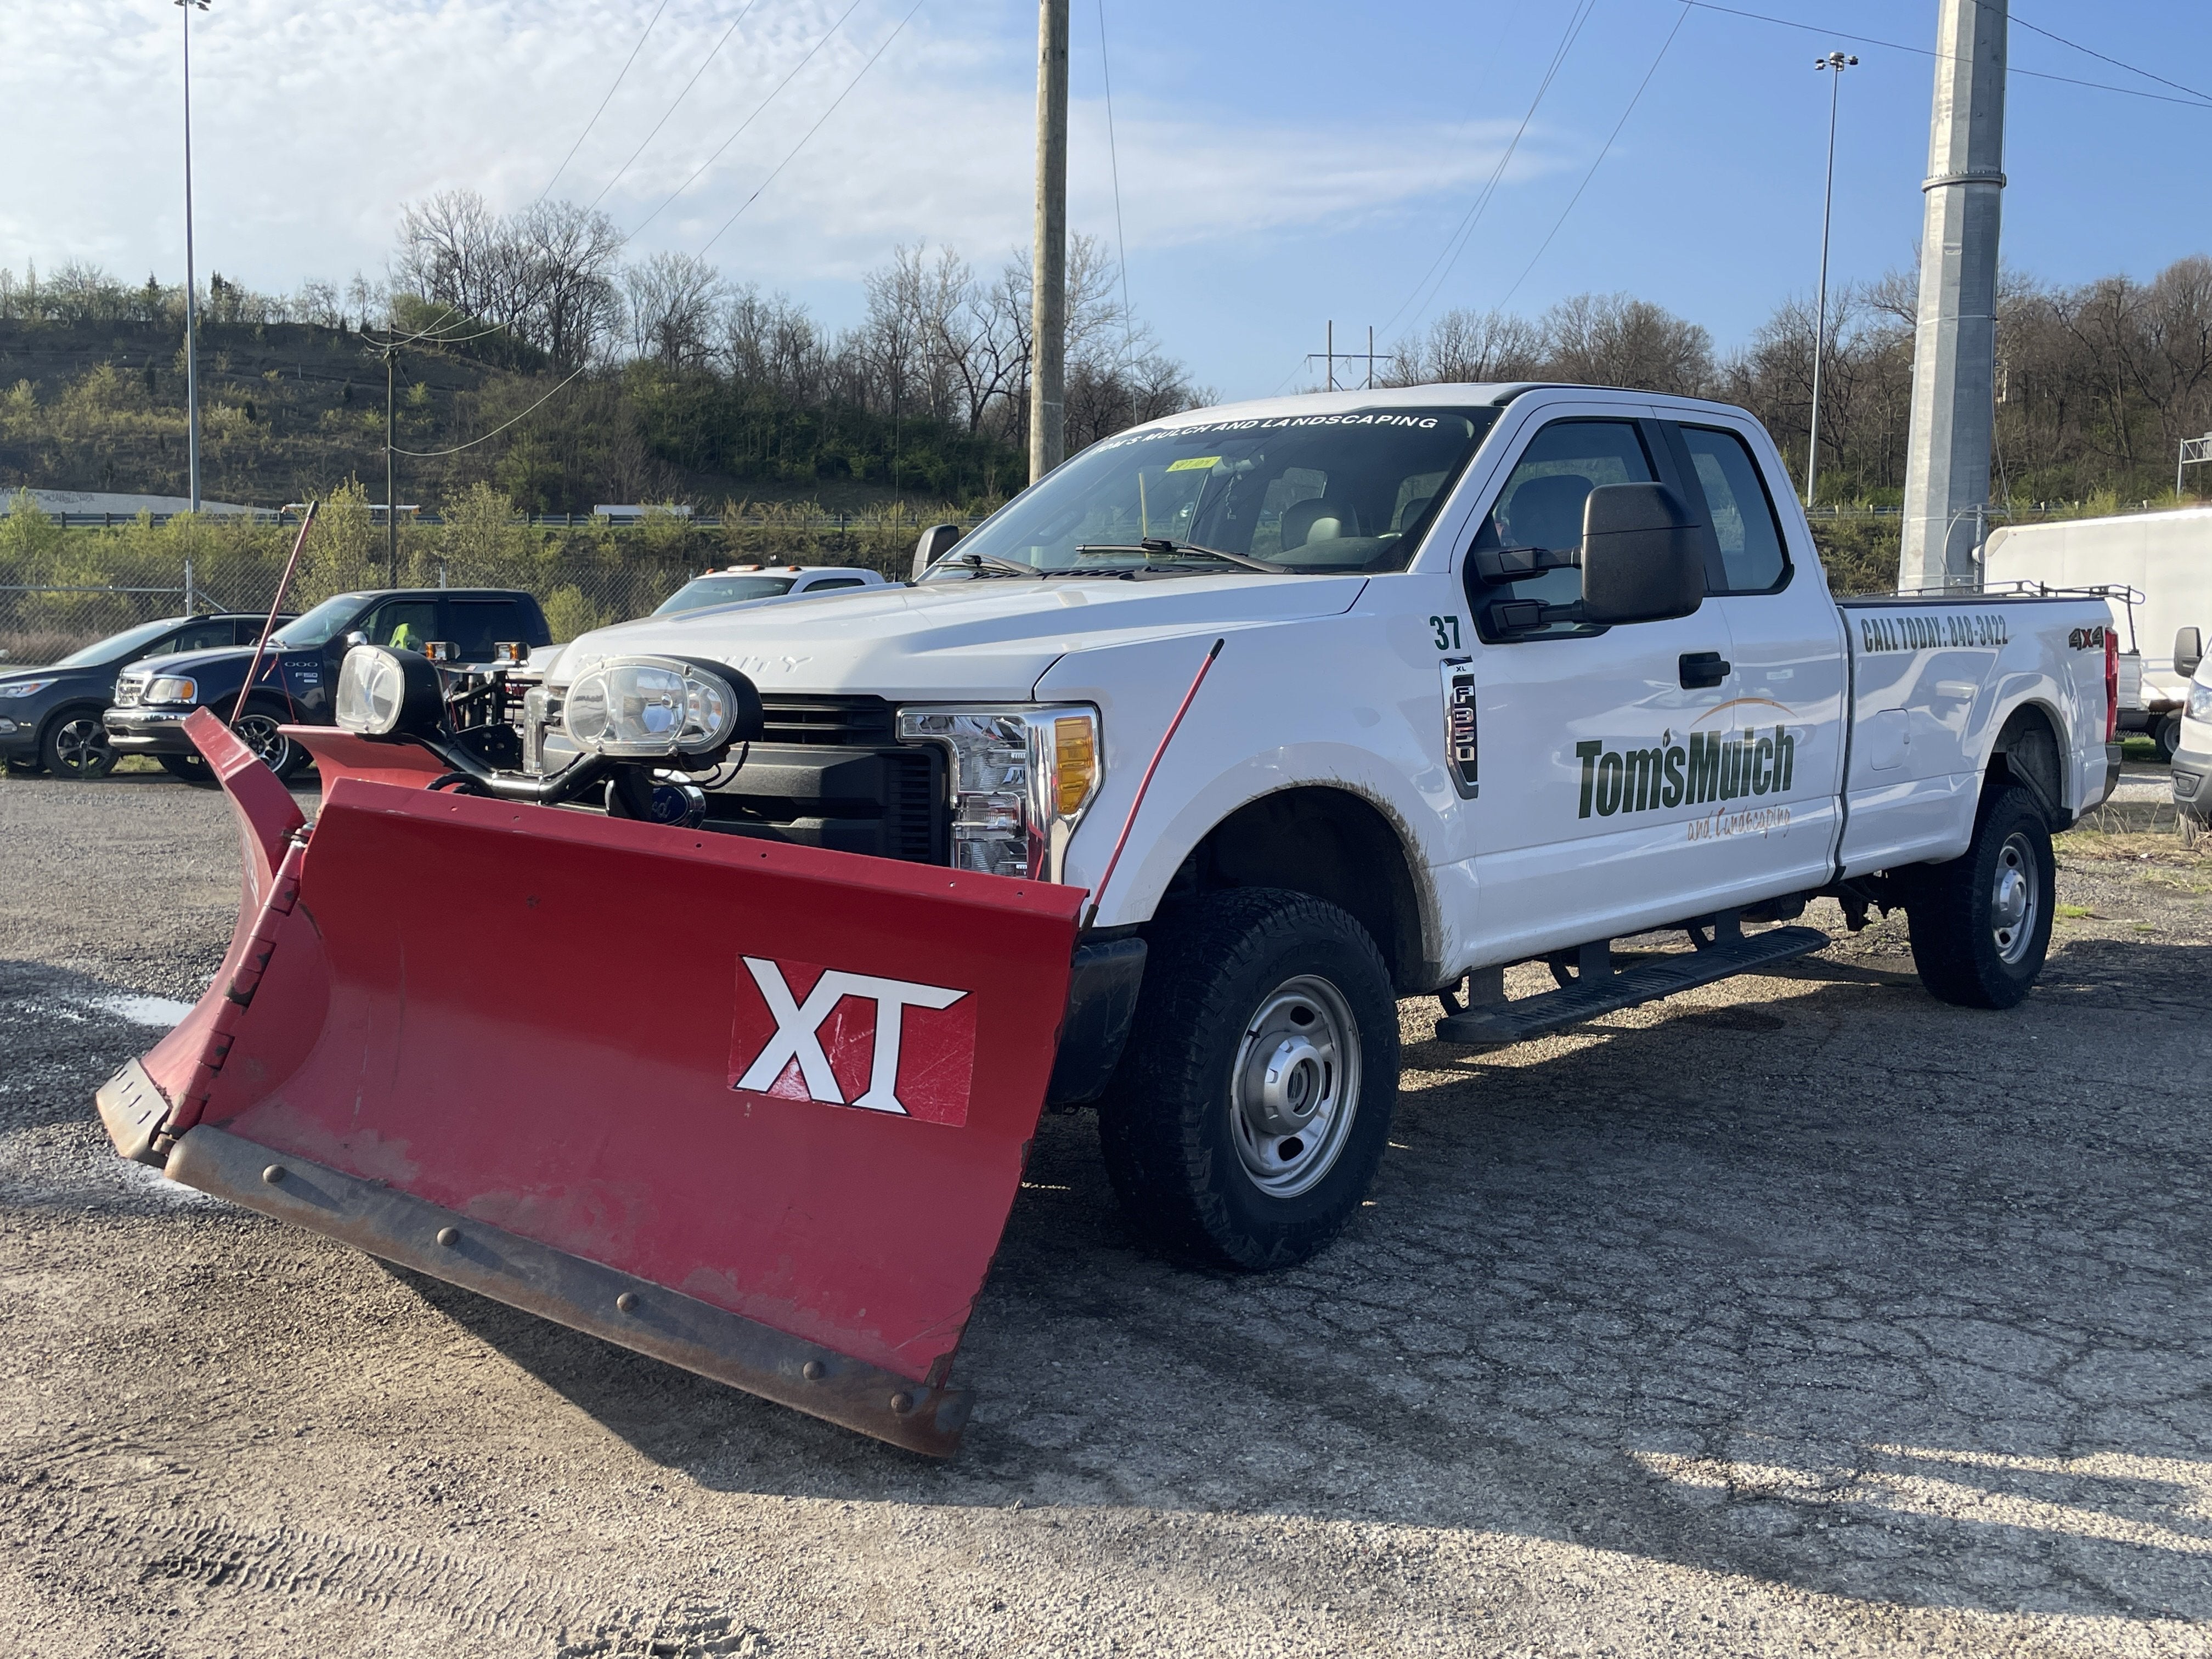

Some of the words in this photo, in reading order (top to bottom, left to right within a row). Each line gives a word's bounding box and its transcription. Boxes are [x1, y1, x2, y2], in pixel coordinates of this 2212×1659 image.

[1091, 436, 1143, 455] TOM'S
[1141, 424, 1212, 442] MULCH
[1211, 419, 1259, 432] AND
[1260, 415, 1438, 428] LANDSCAPING
[1429, 616, 1461, 650] 37
[1861, 618, 1898, 653] CALL
[1896, 617, 1946, 650] TODAY:
[1947, 614, 2008, 647] 848-3422
[733, 953, 975, 1117] XT
